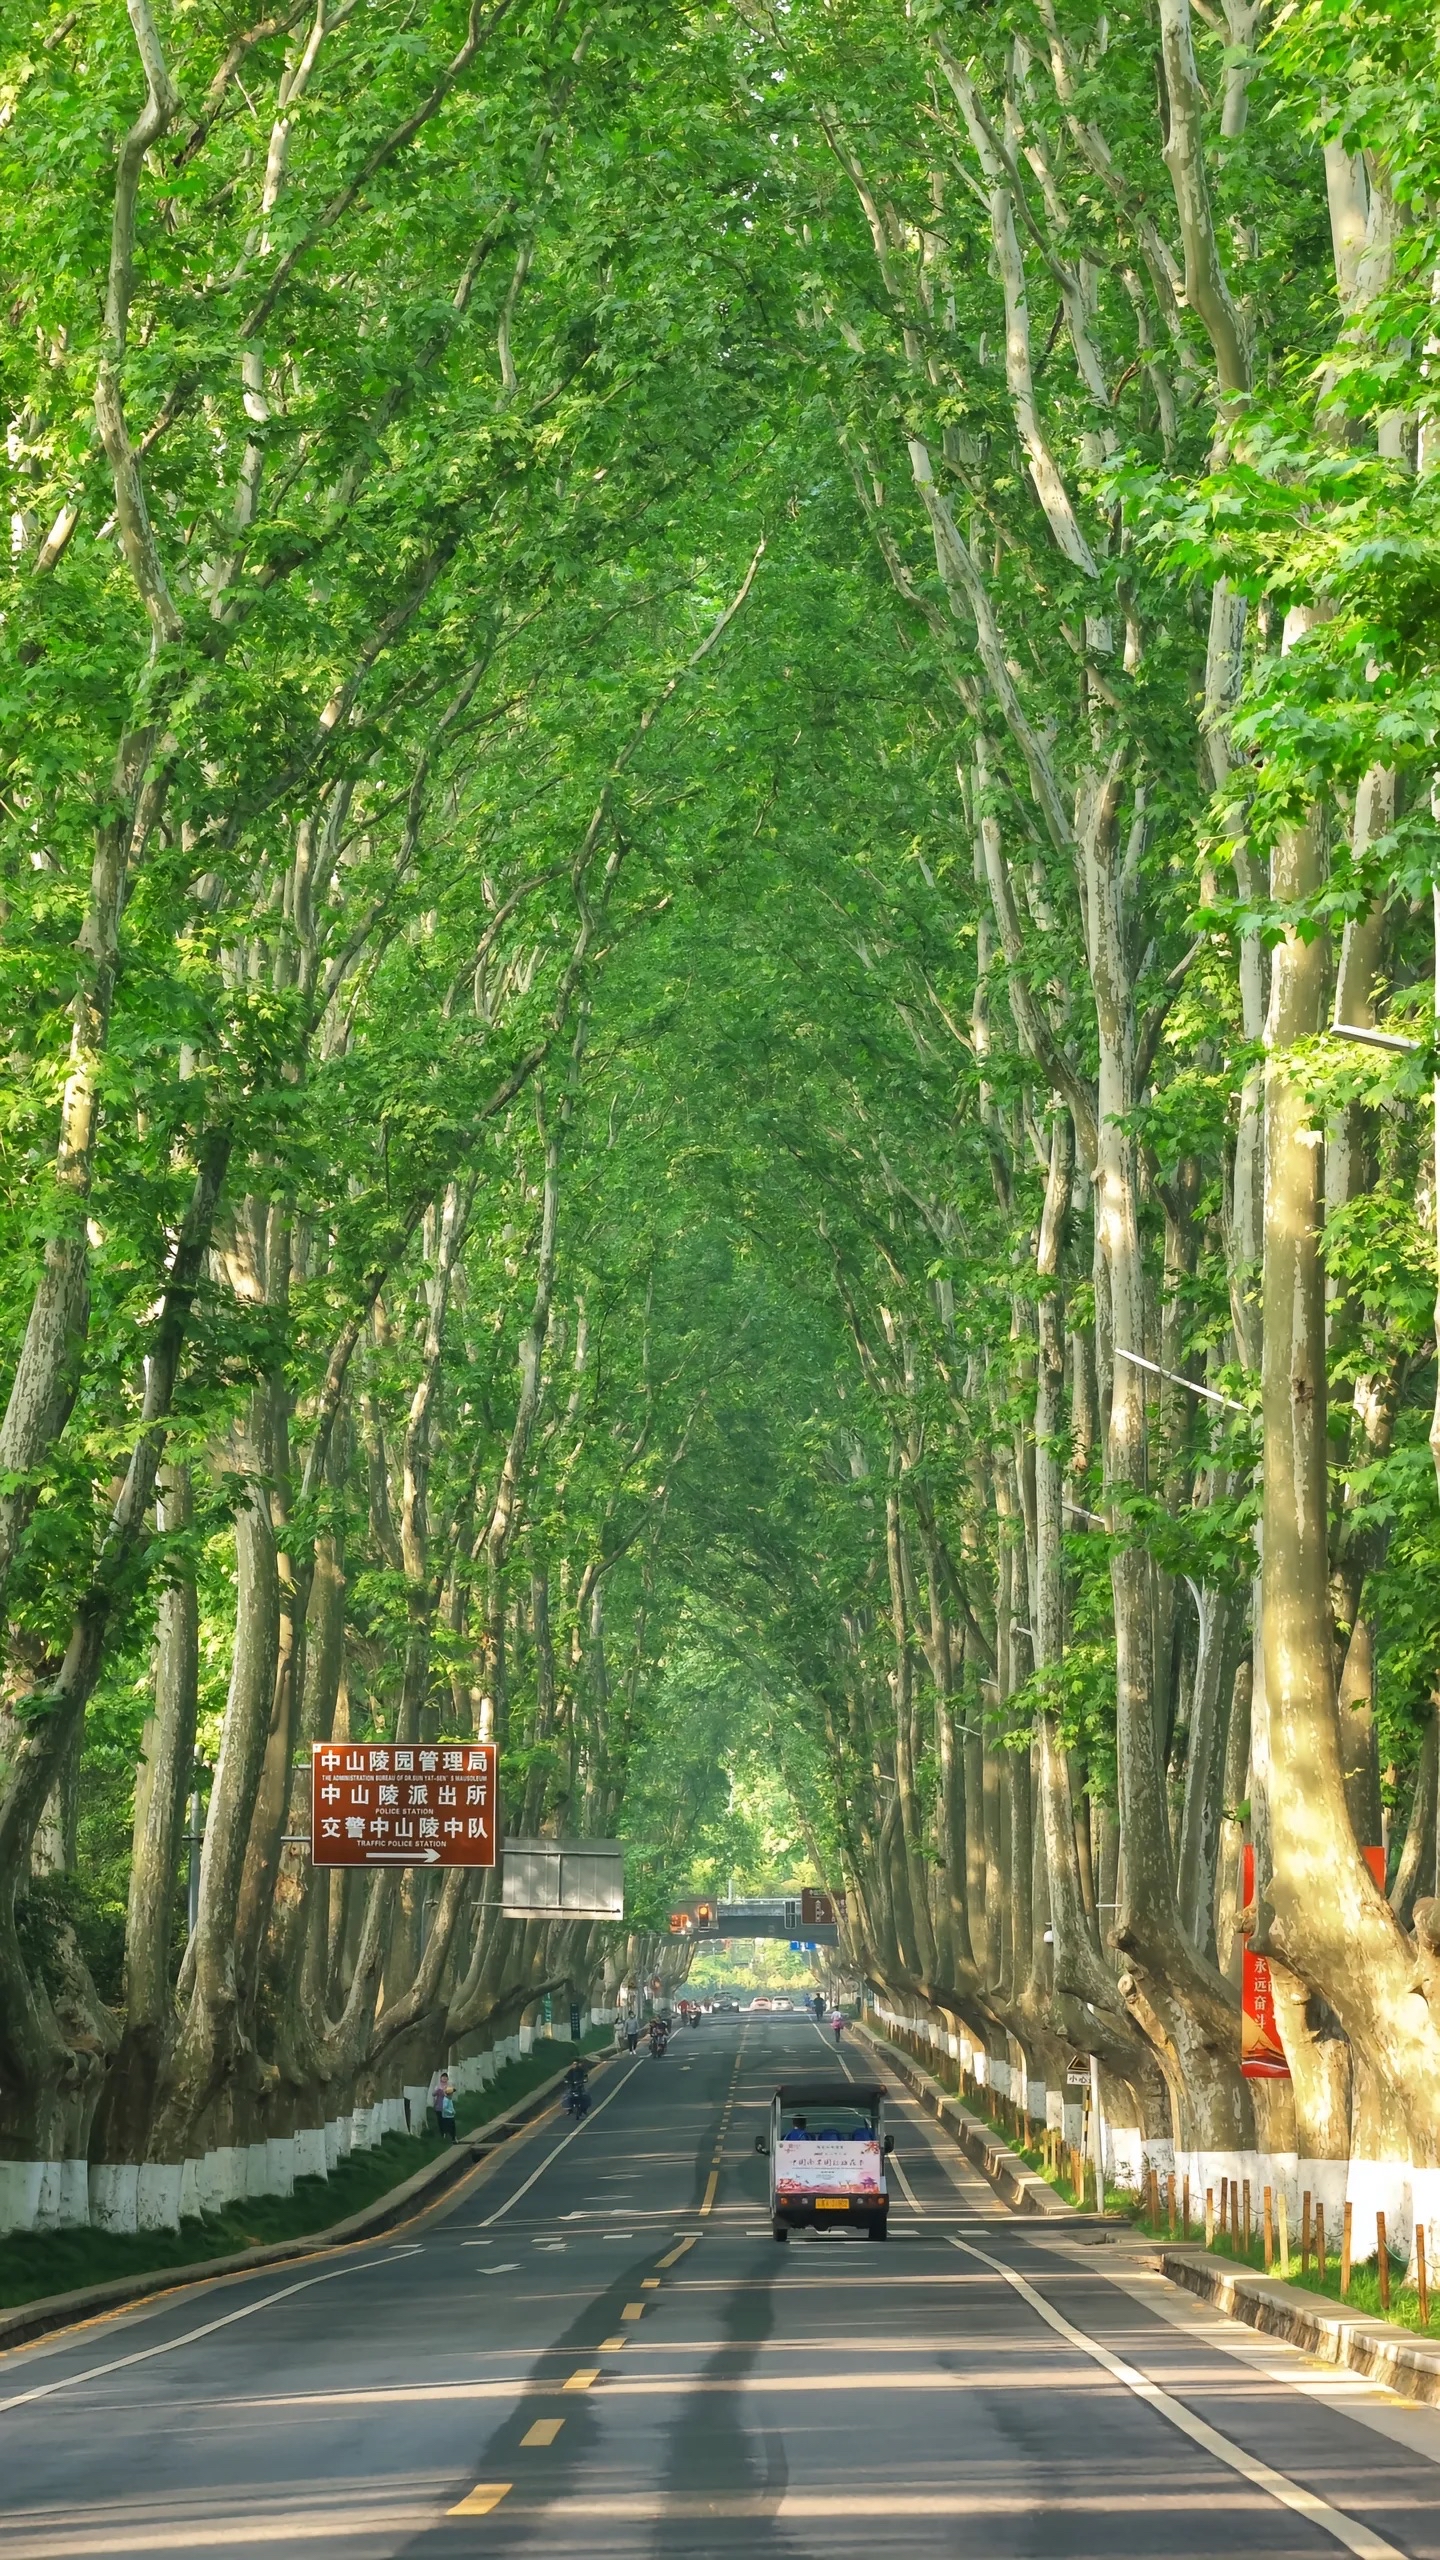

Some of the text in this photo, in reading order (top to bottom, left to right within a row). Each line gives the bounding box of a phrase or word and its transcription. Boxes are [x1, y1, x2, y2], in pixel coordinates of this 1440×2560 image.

[321, 1749, 488, 1772] 中山陵园管理局
[322, 1774, 332, 1782] THE
[333, 1774, 375, 1782] ADMINISTRATION
[375, 1774, 396, 1782] BUREAU
[396, 1774, 404, 1782] OF
[321, 1783, 488, 1806] 中山陵派出所
[321, 1816, 489, 1839] 交警中山陵中队
[1254, 1957, 1268, 2029] 永远奋斗
[1069, 2074, 1091, 2084] 小心
